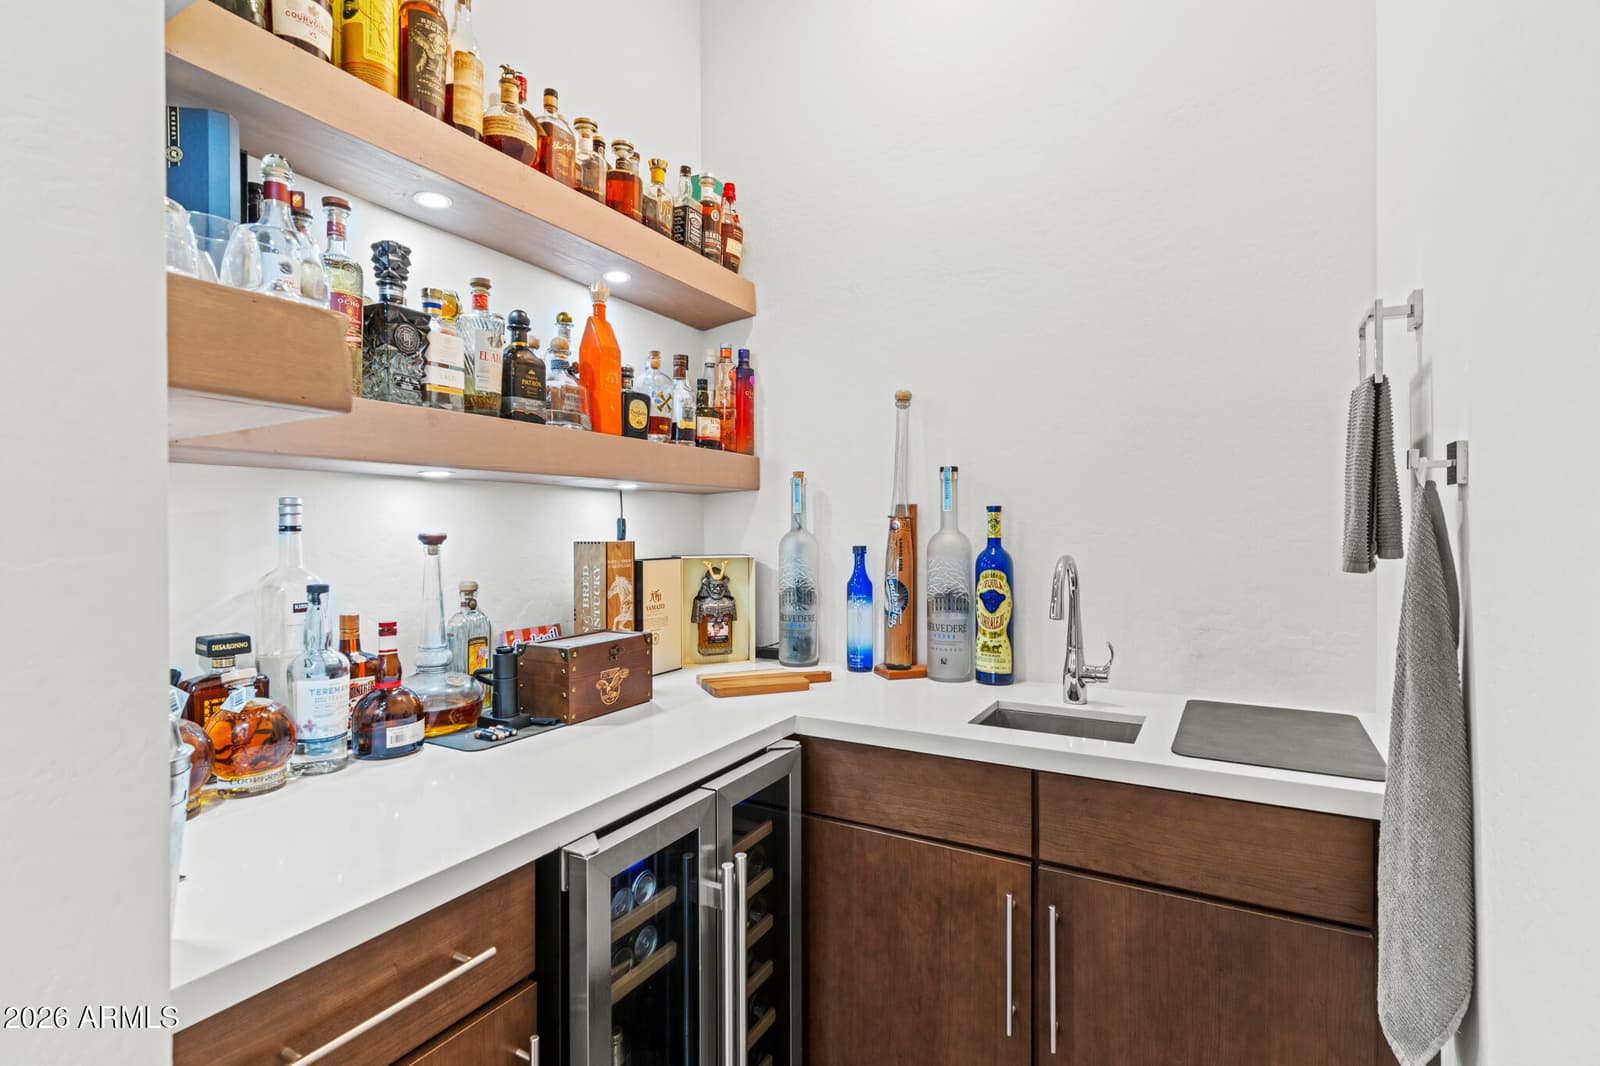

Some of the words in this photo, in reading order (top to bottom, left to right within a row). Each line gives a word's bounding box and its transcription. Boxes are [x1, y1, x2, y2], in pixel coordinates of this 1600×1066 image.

[337, 298, 360, 308] OCHO
[480, 351, 488, 361] EL
[582, 565, 590, 609] BRED
[593, 565, 601, 630] NTUCKY
[927, 623, 968, 633] BELVEDERE
[211, 641, 249, 652] DISARONNO
